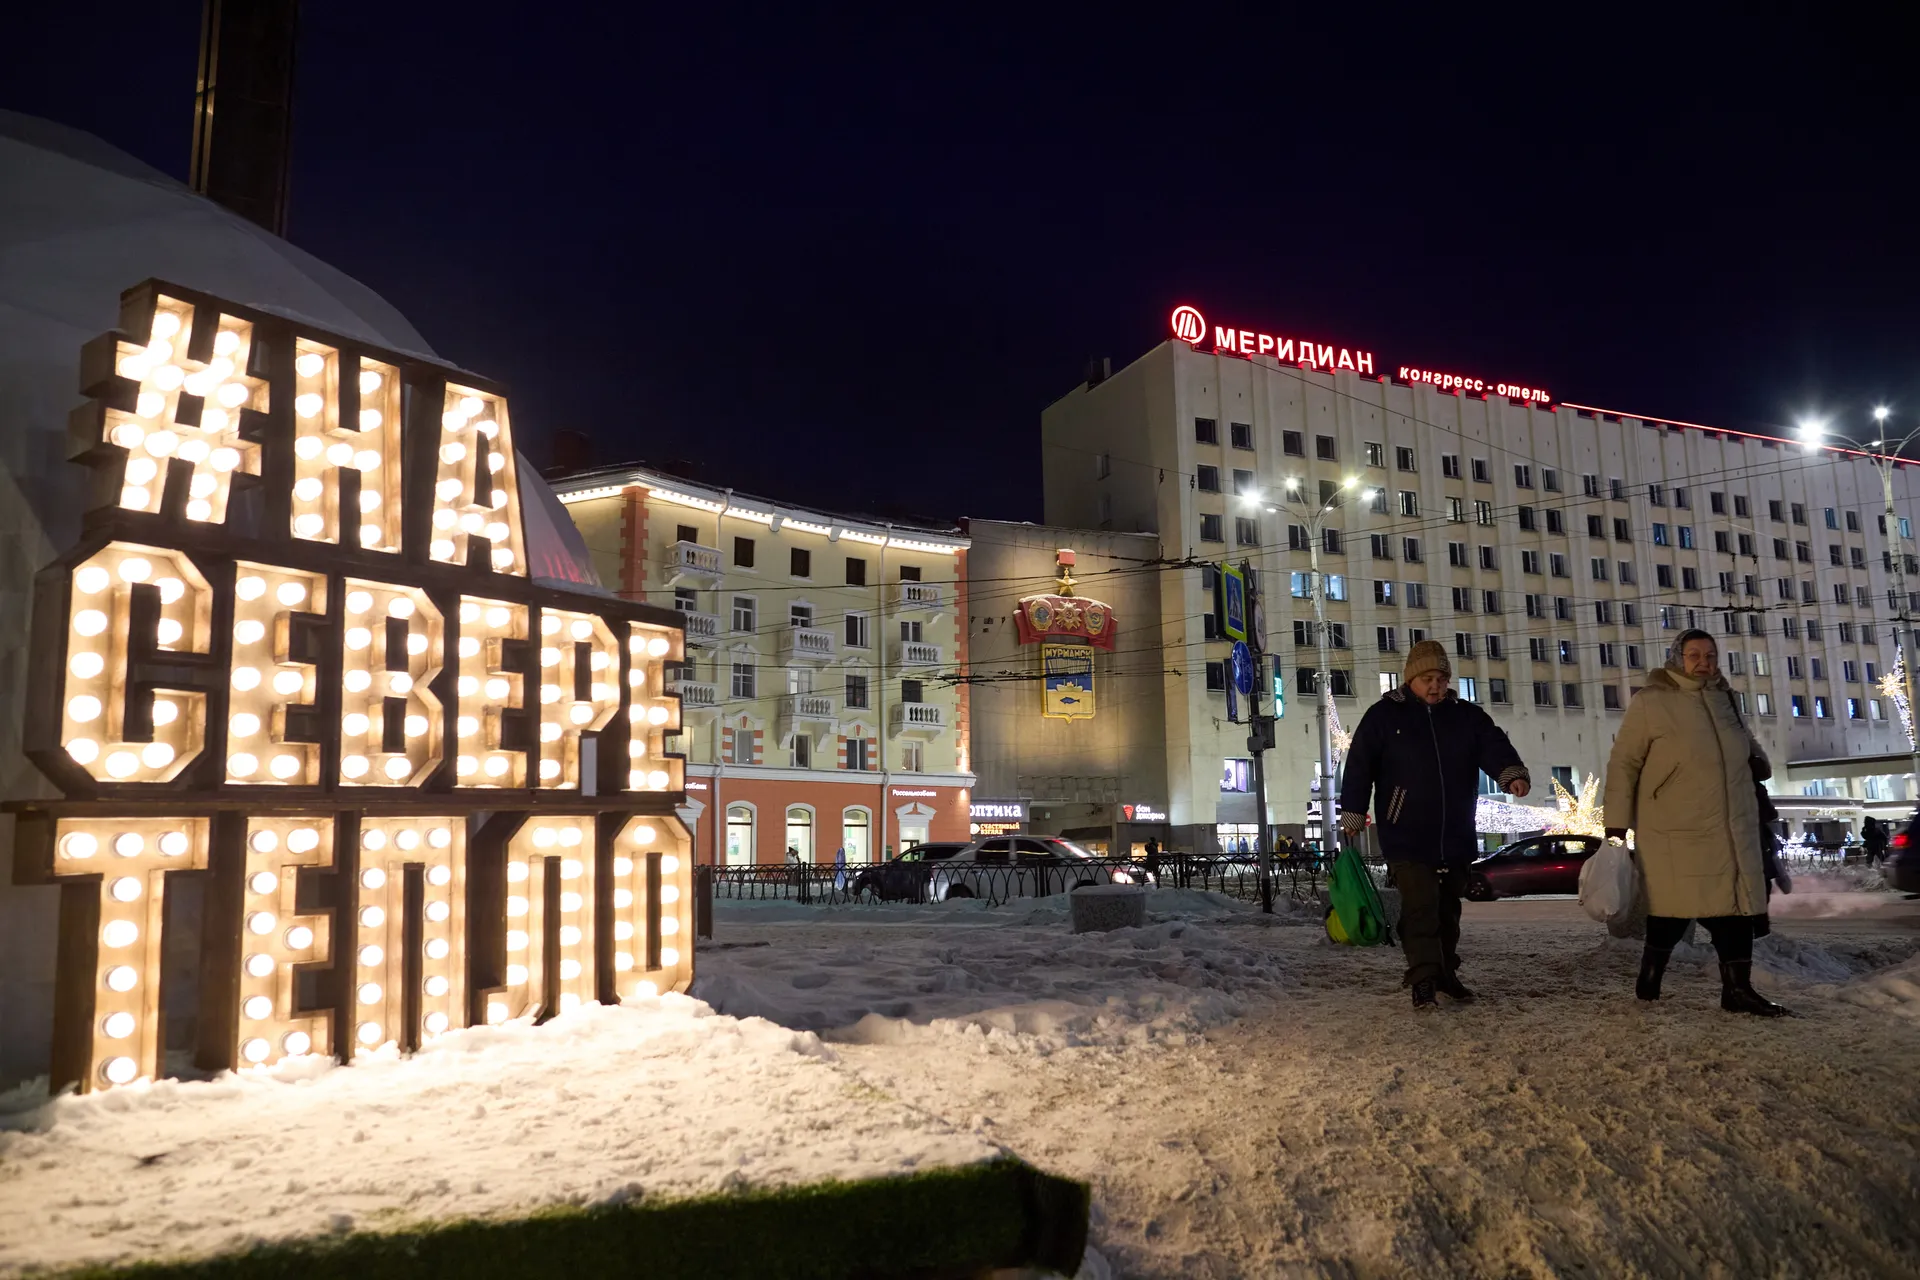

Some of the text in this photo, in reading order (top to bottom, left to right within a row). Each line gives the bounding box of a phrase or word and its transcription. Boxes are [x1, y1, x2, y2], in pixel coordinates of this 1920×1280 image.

[102, 293, 528, 577] #НА
[1215, 326, 1373, 374] МЕРИДИАН
[60, 540, 686, 793] СЕВЕРЕ
[1045, 648, 1092, 658] МУРМАНСК
[55, 816, 693, 1094] ТЕПЛО
